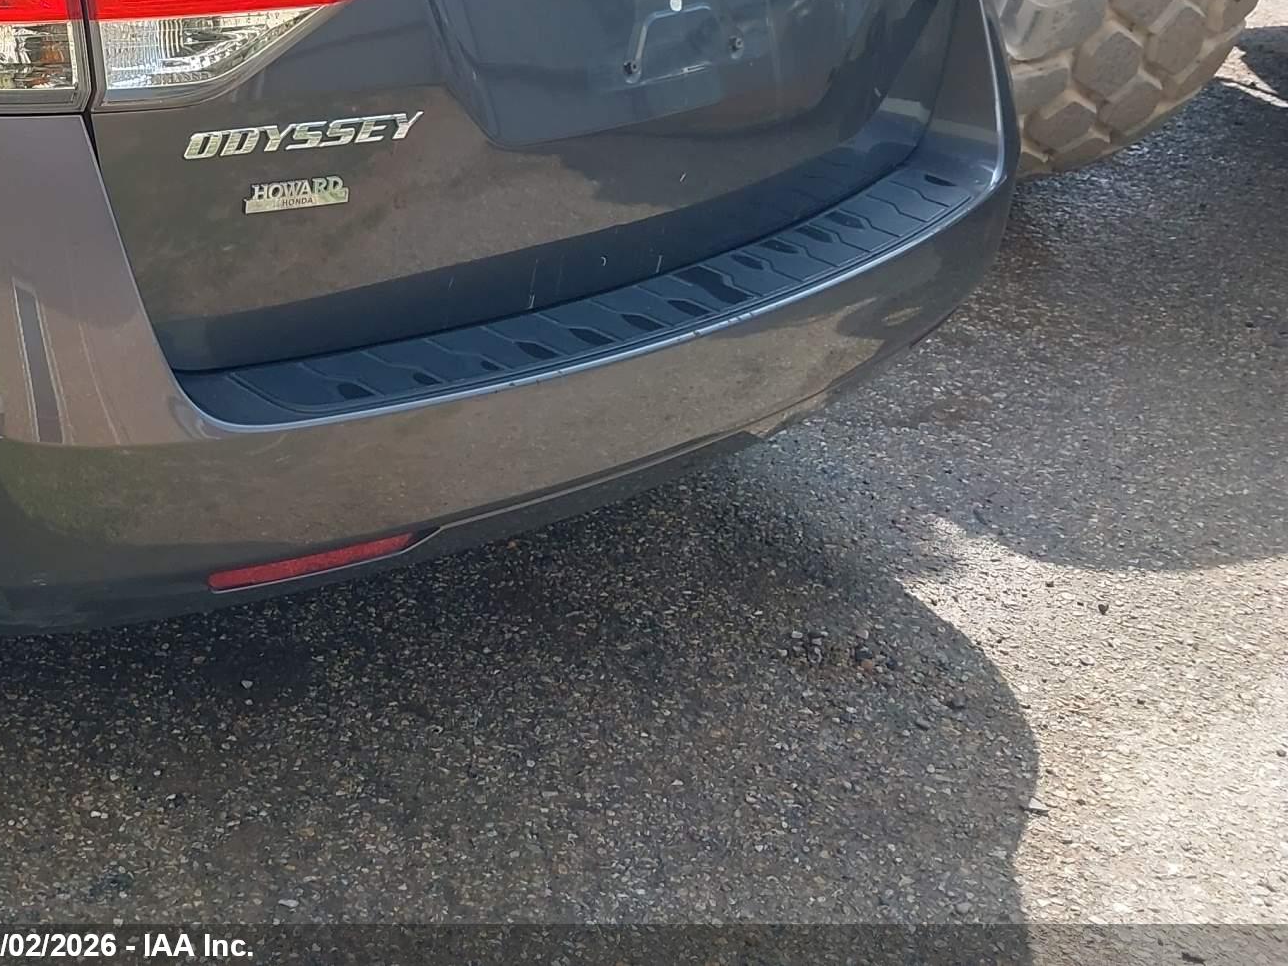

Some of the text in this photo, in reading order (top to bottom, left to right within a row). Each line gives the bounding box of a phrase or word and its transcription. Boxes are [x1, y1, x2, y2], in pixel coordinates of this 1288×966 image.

[184, 111, 424, 159] ODYSSEY
[251, 176, 347, 202] HOWARD
[281, 196, 314, 207] HONDA
